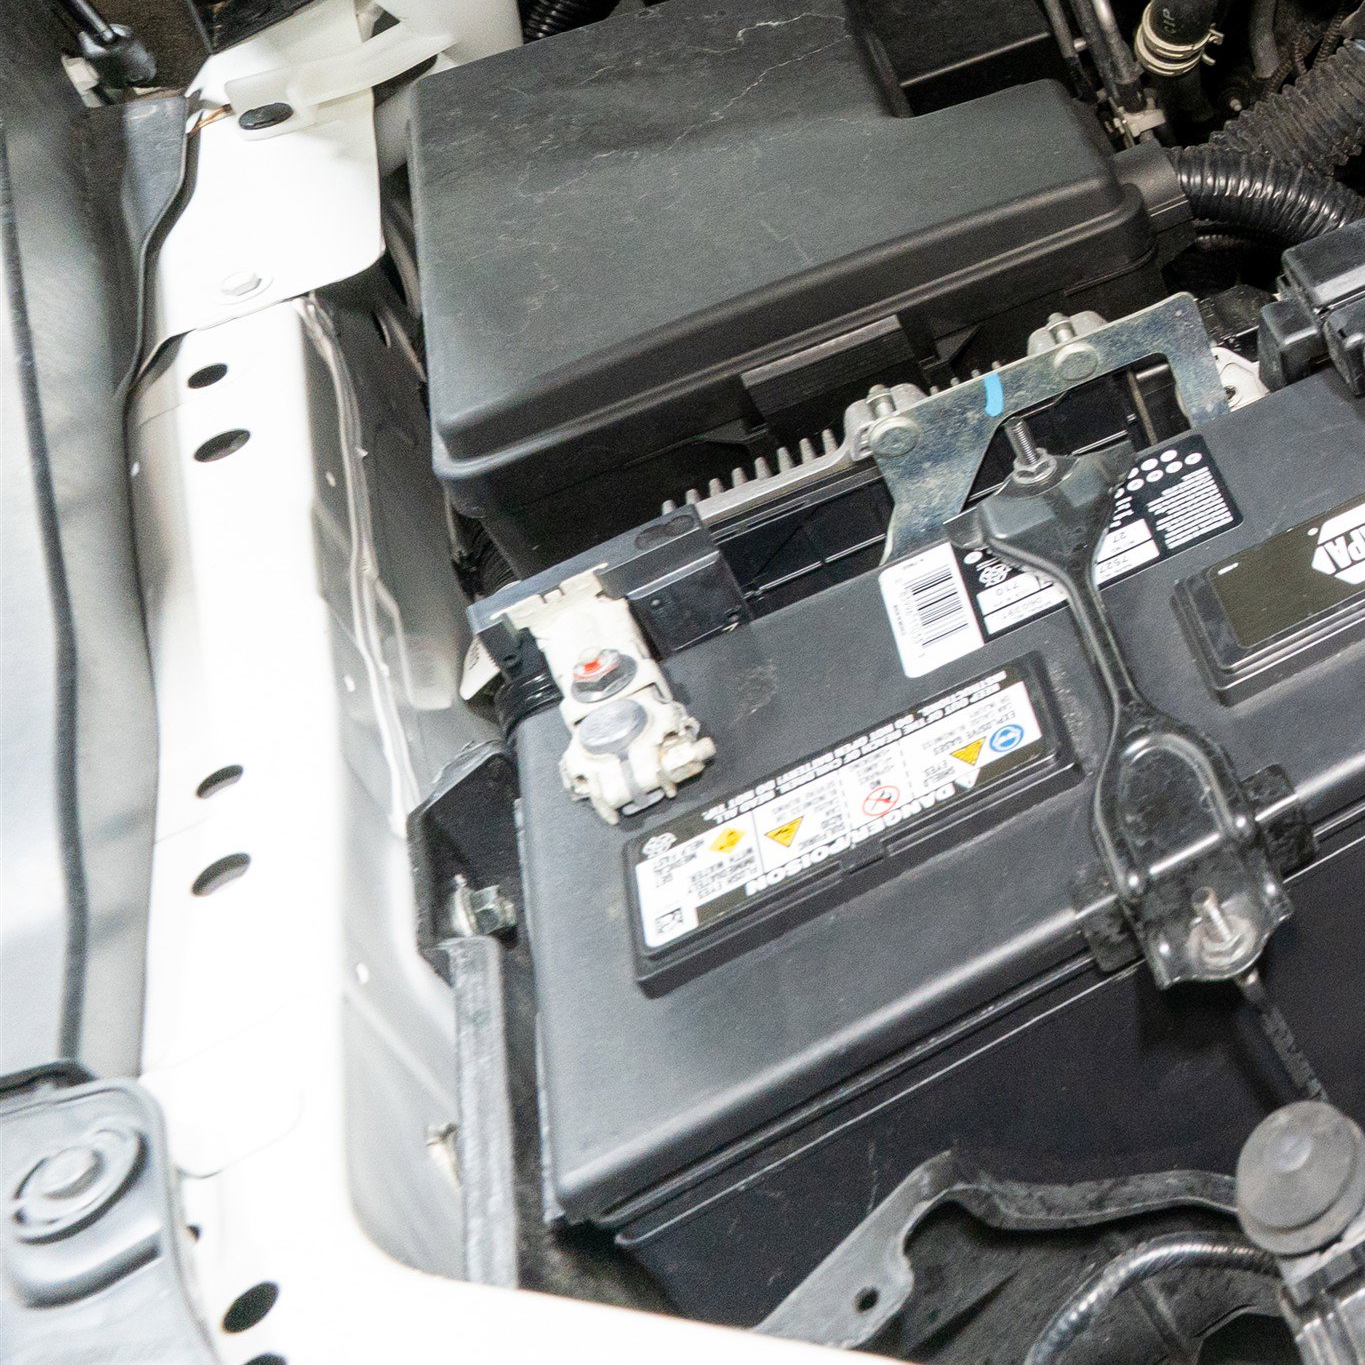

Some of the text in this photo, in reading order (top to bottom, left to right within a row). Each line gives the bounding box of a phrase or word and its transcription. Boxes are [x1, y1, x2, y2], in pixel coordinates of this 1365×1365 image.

[1110, 531, 1127, 543] 27
[1097, 555, 1128, 573] 7527
[921, 766, 955, 787] SHIELD
[922, 759, 948, 776] EYES
[743, 782, 956, 896] DANGER/POISON
